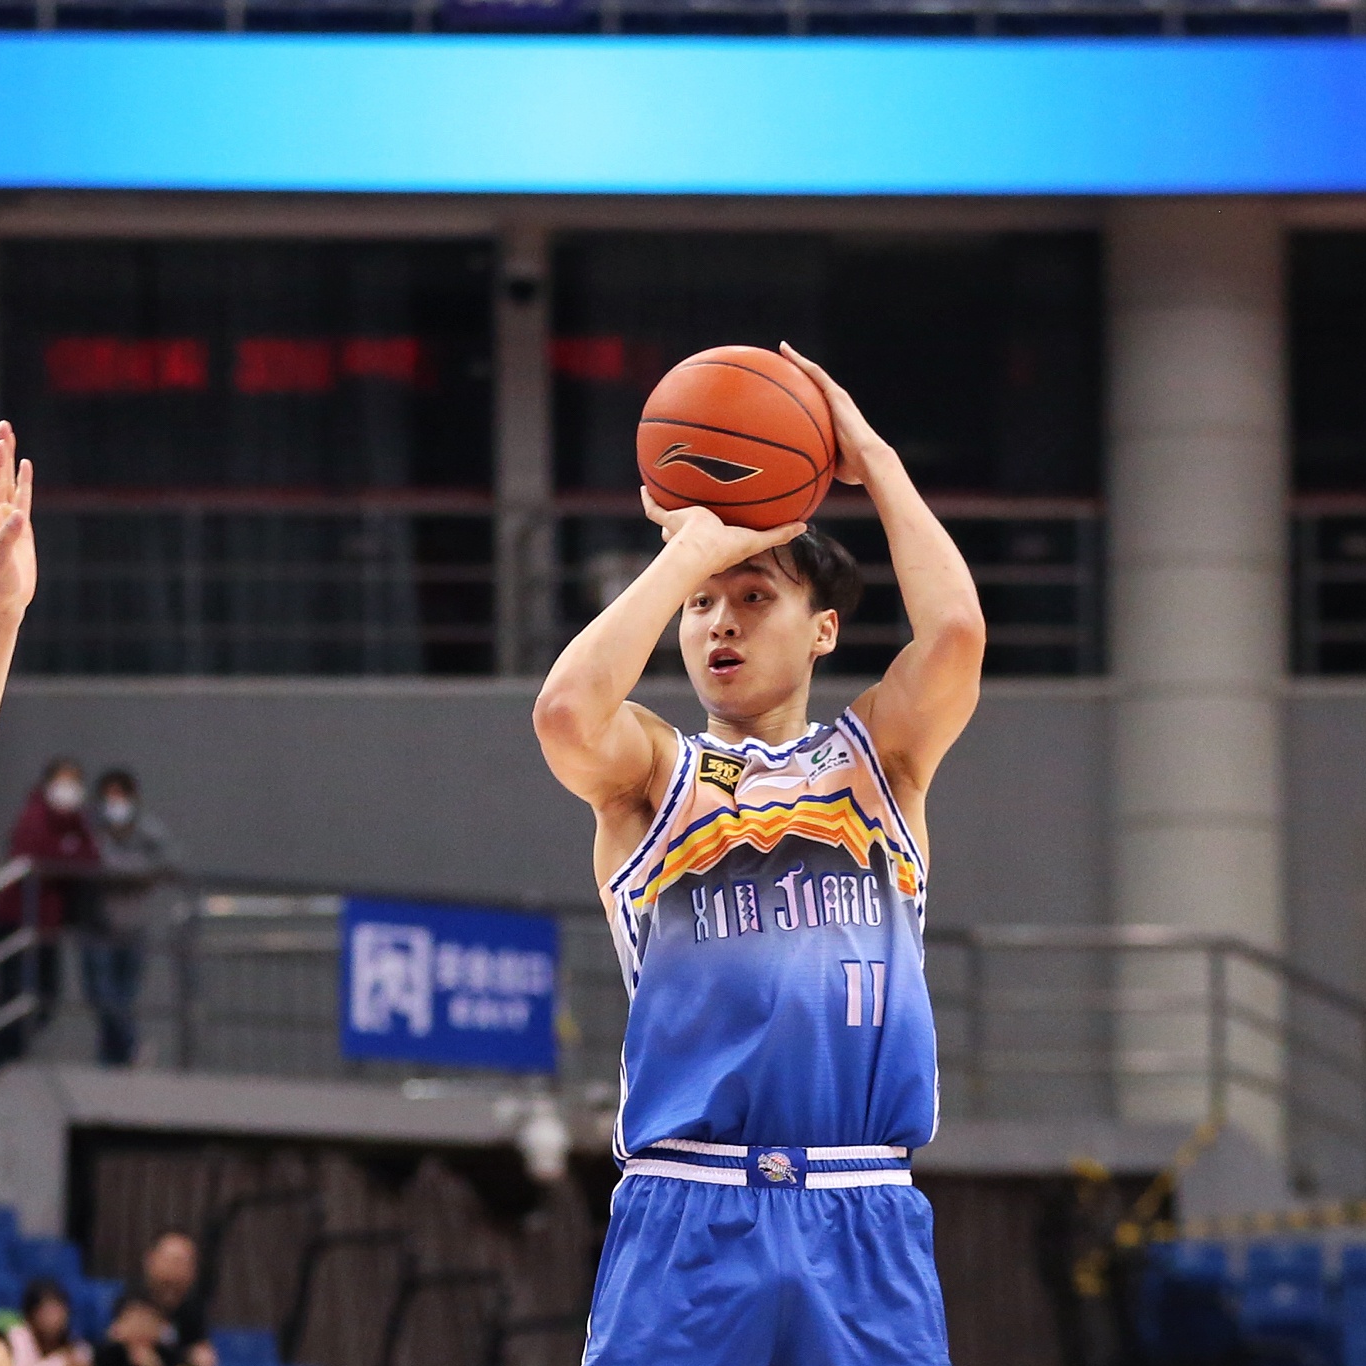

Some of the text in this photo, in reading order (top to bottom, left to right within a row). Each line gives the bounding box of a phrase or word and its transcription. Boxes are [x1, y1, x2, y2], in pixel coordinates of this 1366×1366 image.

[691, 860, 882, 944] XIN JIANG
[840, 959, 885, 1027] 11
